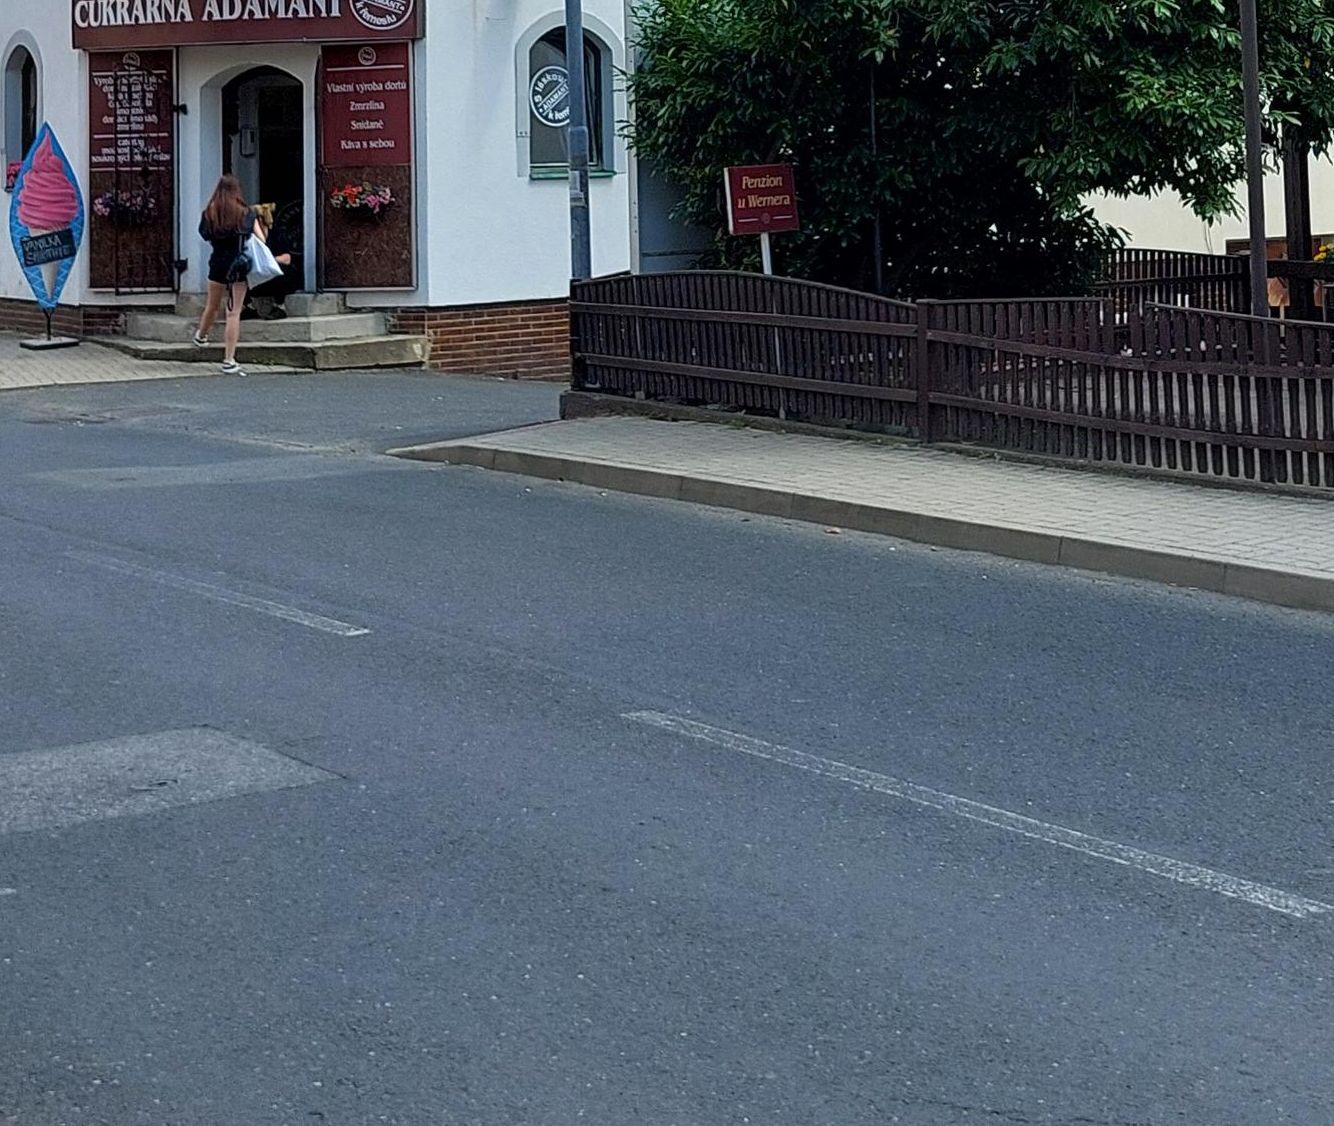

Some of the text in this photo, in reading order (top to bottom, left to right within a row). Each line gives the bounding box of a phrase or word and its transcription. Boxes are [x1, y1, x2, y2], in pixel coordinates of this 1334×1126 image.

[326, 80, 407, 94] Vlastní výroba dortů
[349, 100, 385, 111] Zmrzlina
[350, 120, 384, 130] Snídaně
[340, 139, 395, 150] Káva s sebou
[741, 174, 783, 190] Penzion
[738, 194, 791, 208] u Wernera
